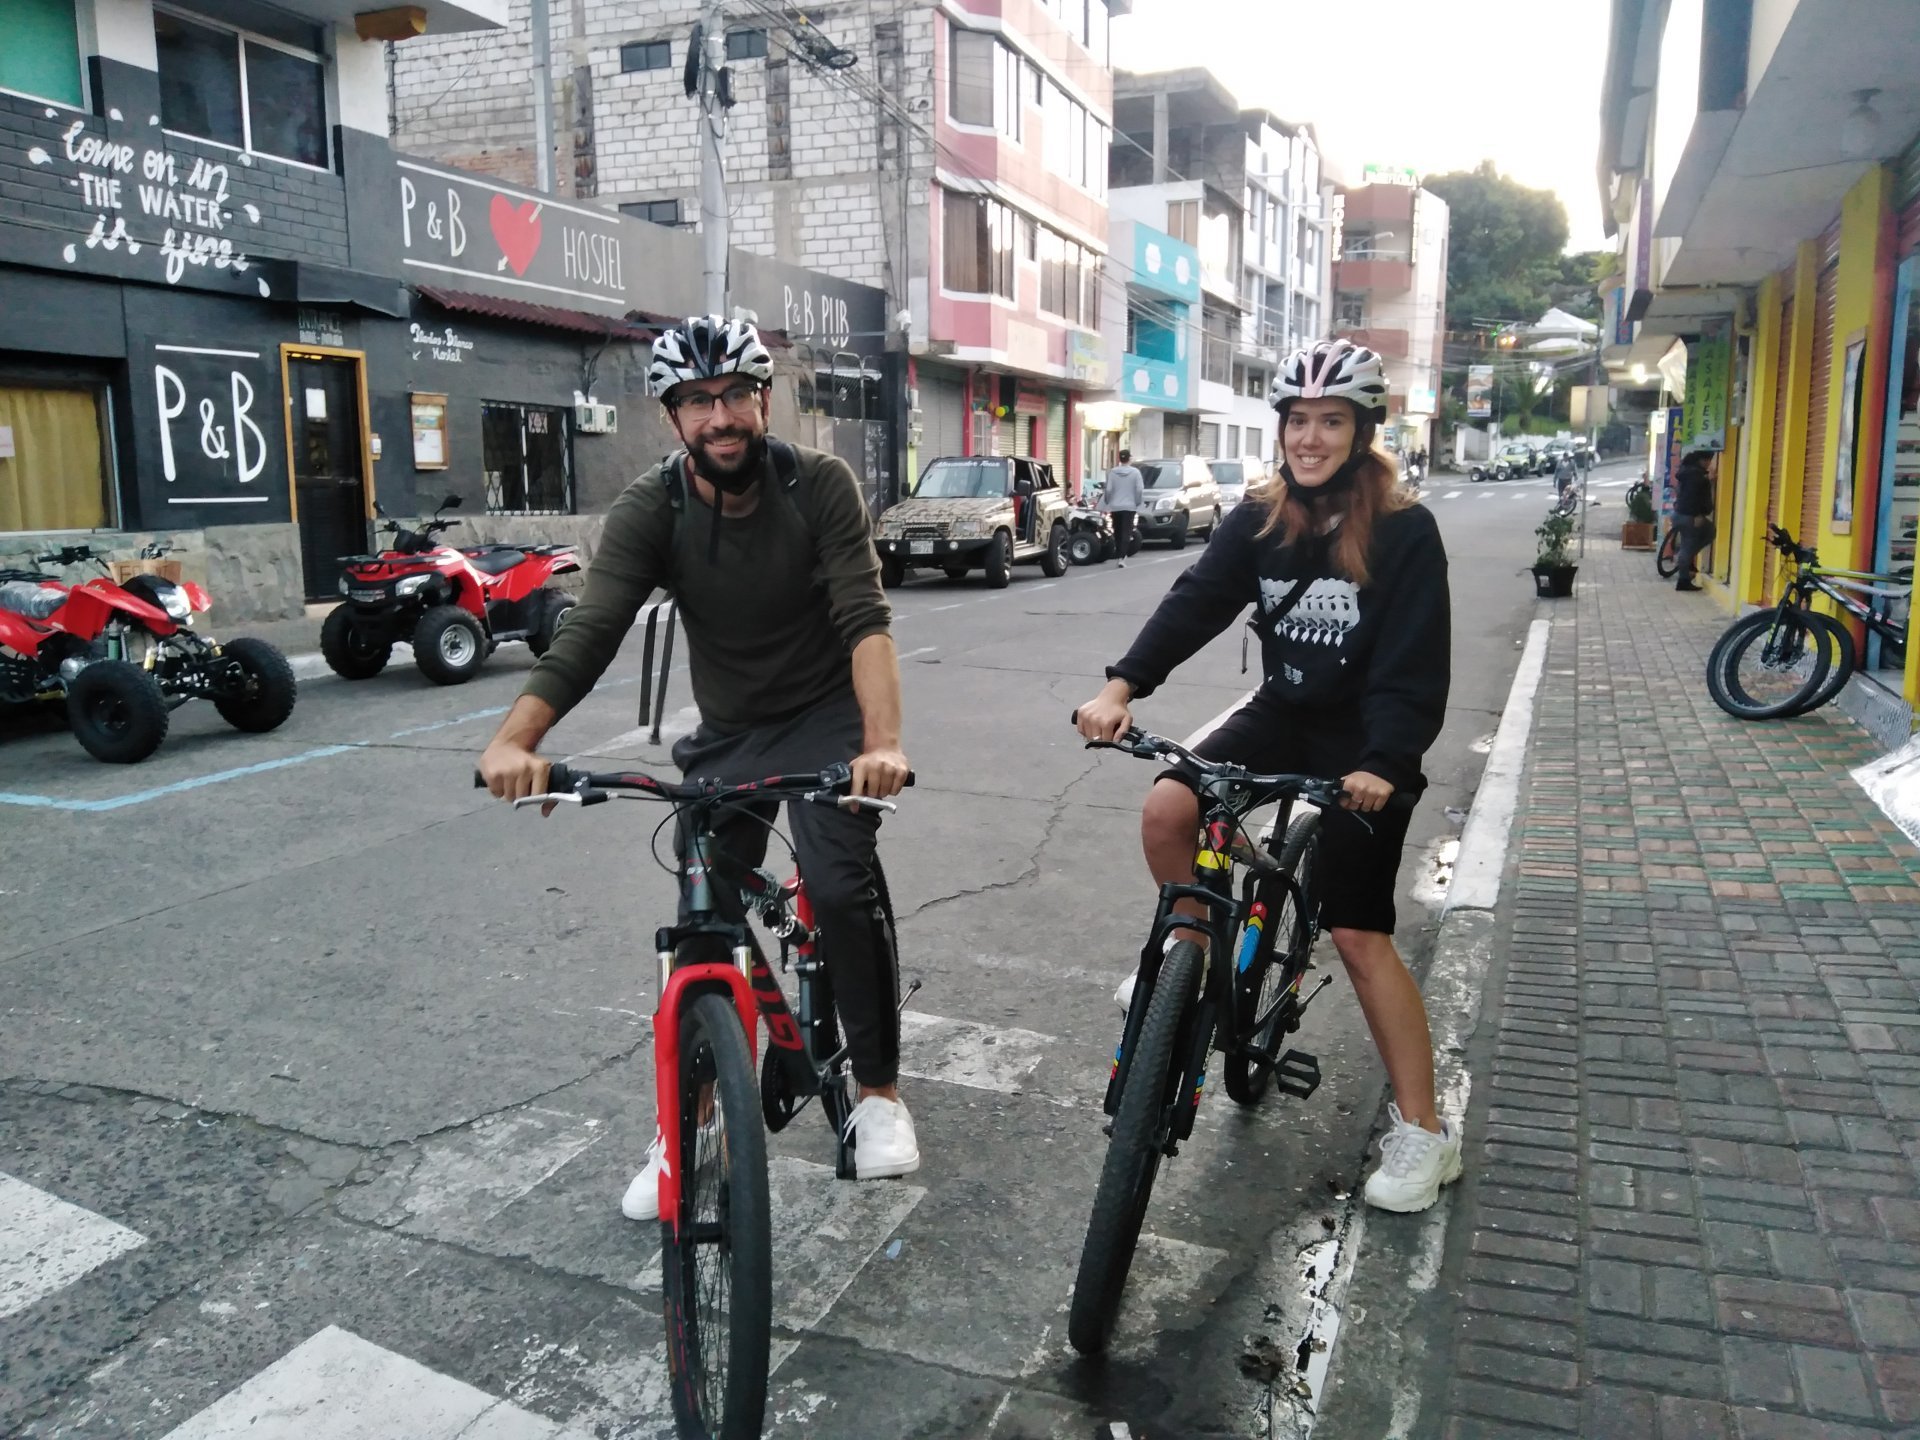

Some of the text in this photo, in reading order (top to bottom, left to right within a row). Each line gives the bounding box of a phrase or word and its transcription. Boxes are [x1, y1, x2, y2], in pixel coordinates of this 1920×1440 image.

[62, 121, 135, 174] Come
[143, 149, 179, 187] on
[563, 226, 626, 291] HOSTEL
[822, 295, 850, 348] PUB
